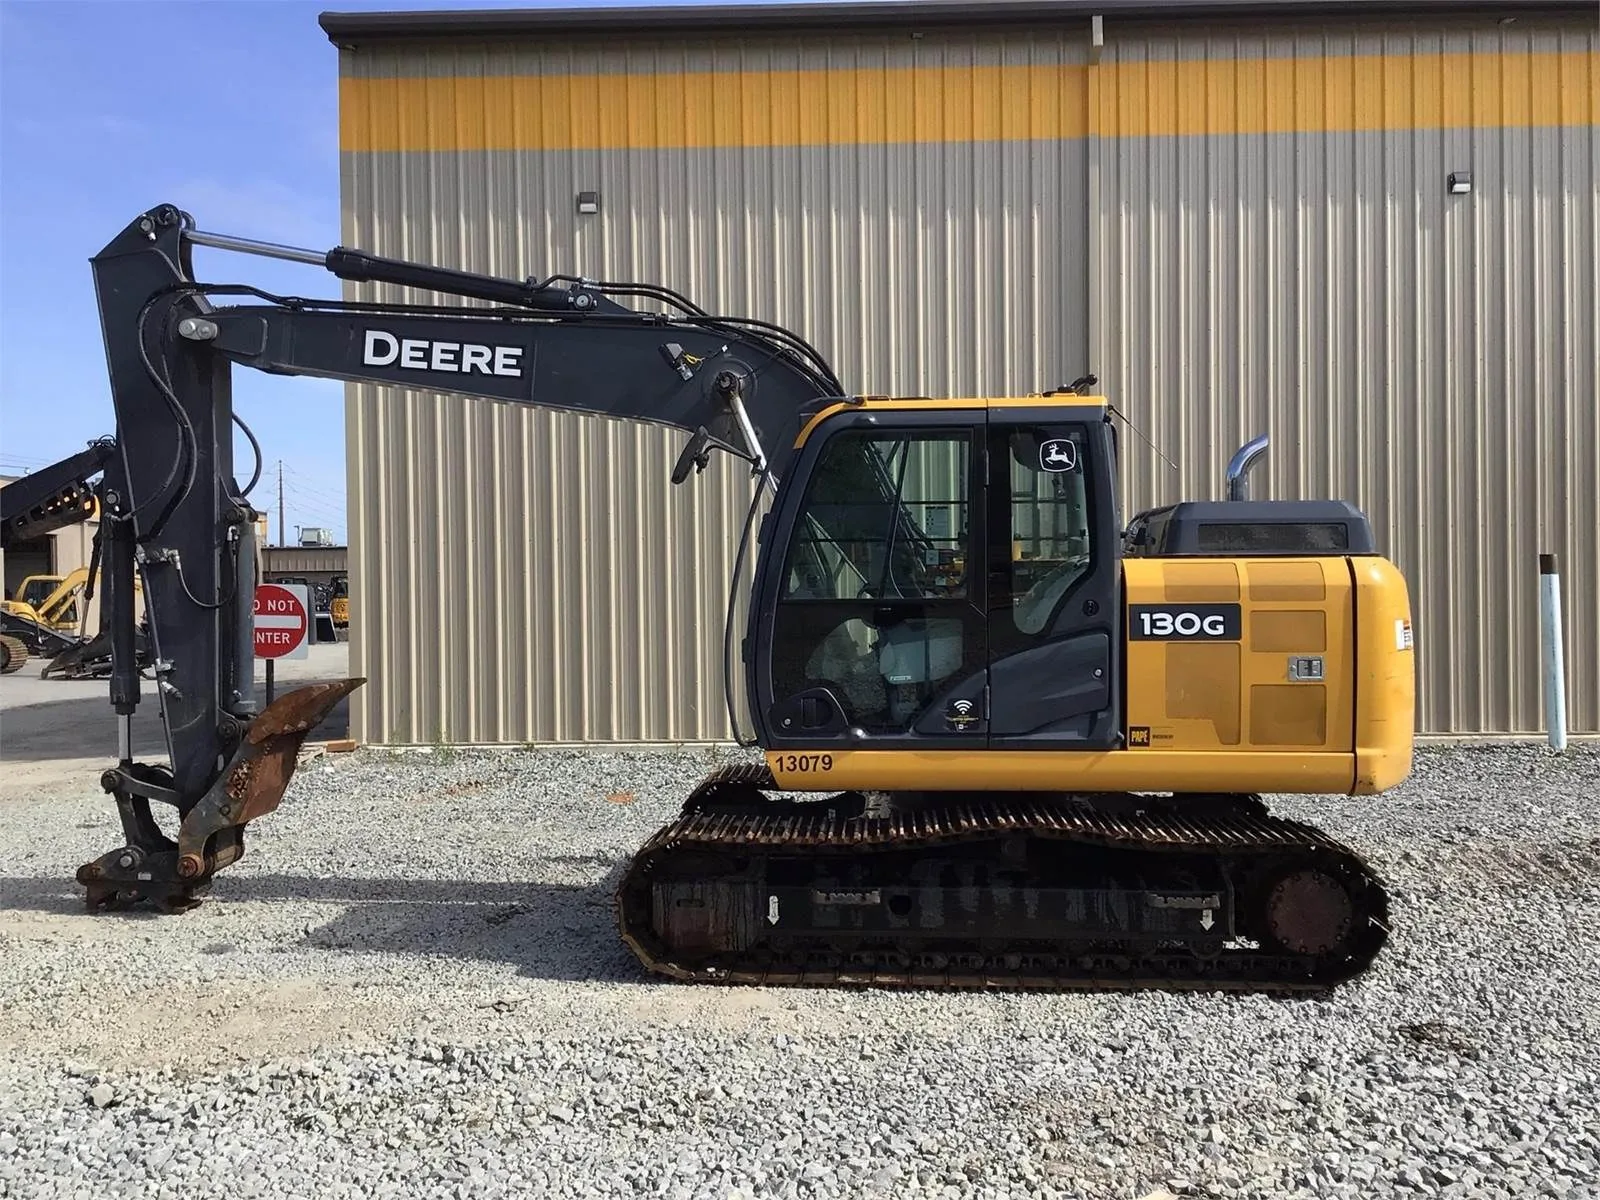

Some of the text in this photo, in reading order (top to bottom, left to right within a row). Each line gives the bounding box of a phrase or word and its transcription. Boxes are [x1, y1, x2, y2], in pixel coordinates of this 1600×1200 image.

[363, 329, 523, 377] DEERE
[253, 599, 295, 612] O NOT
[1140, 612, 1224, 636] 130G
[254, 631, 290, 644] NTER
[775, 755, 833, 772] 13079
